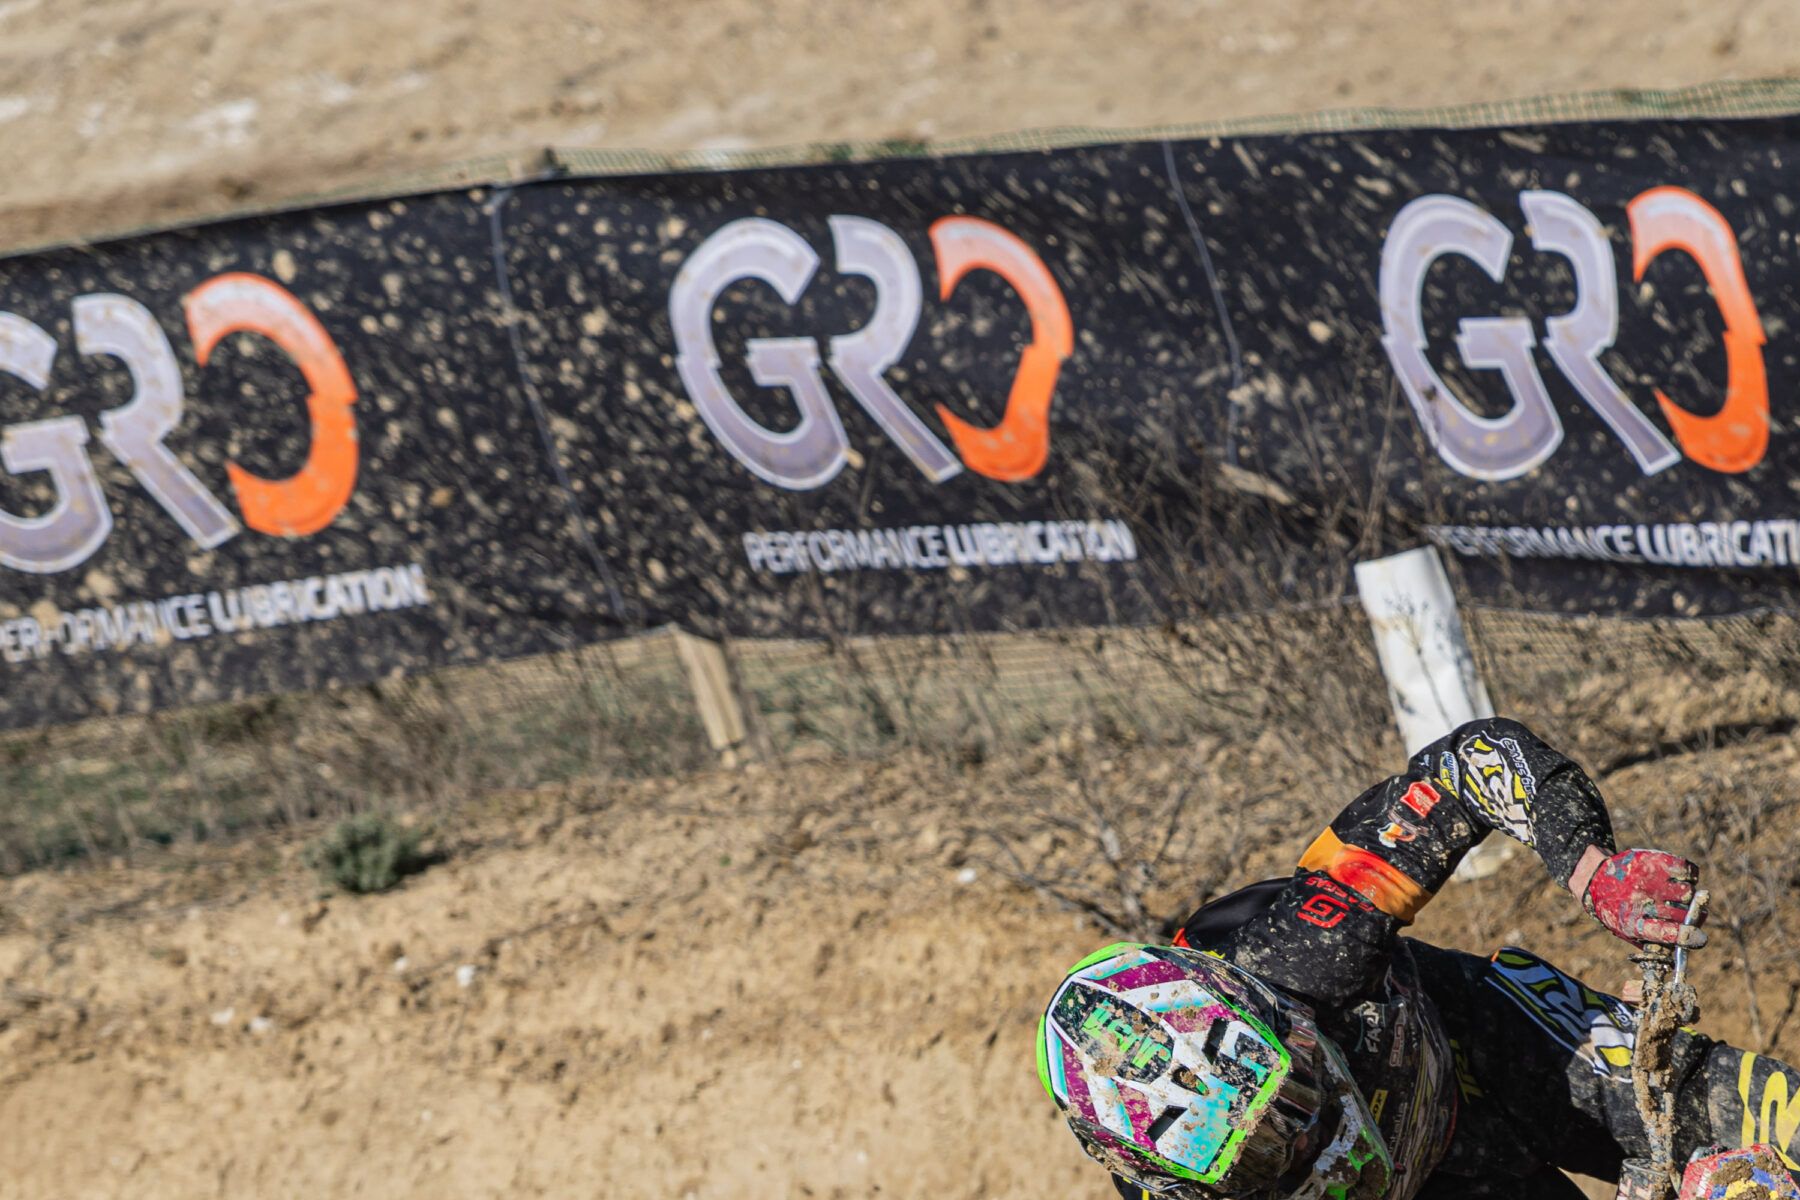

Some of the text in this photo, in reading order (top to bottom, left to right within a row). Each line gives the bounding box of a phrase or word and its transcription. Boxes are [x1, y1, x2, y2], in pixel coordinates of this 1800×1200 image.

[743, 519, 1138, 574] PERFORMANCE LUBRICATION
[207, 563, 430, 633] LUBRICATION
